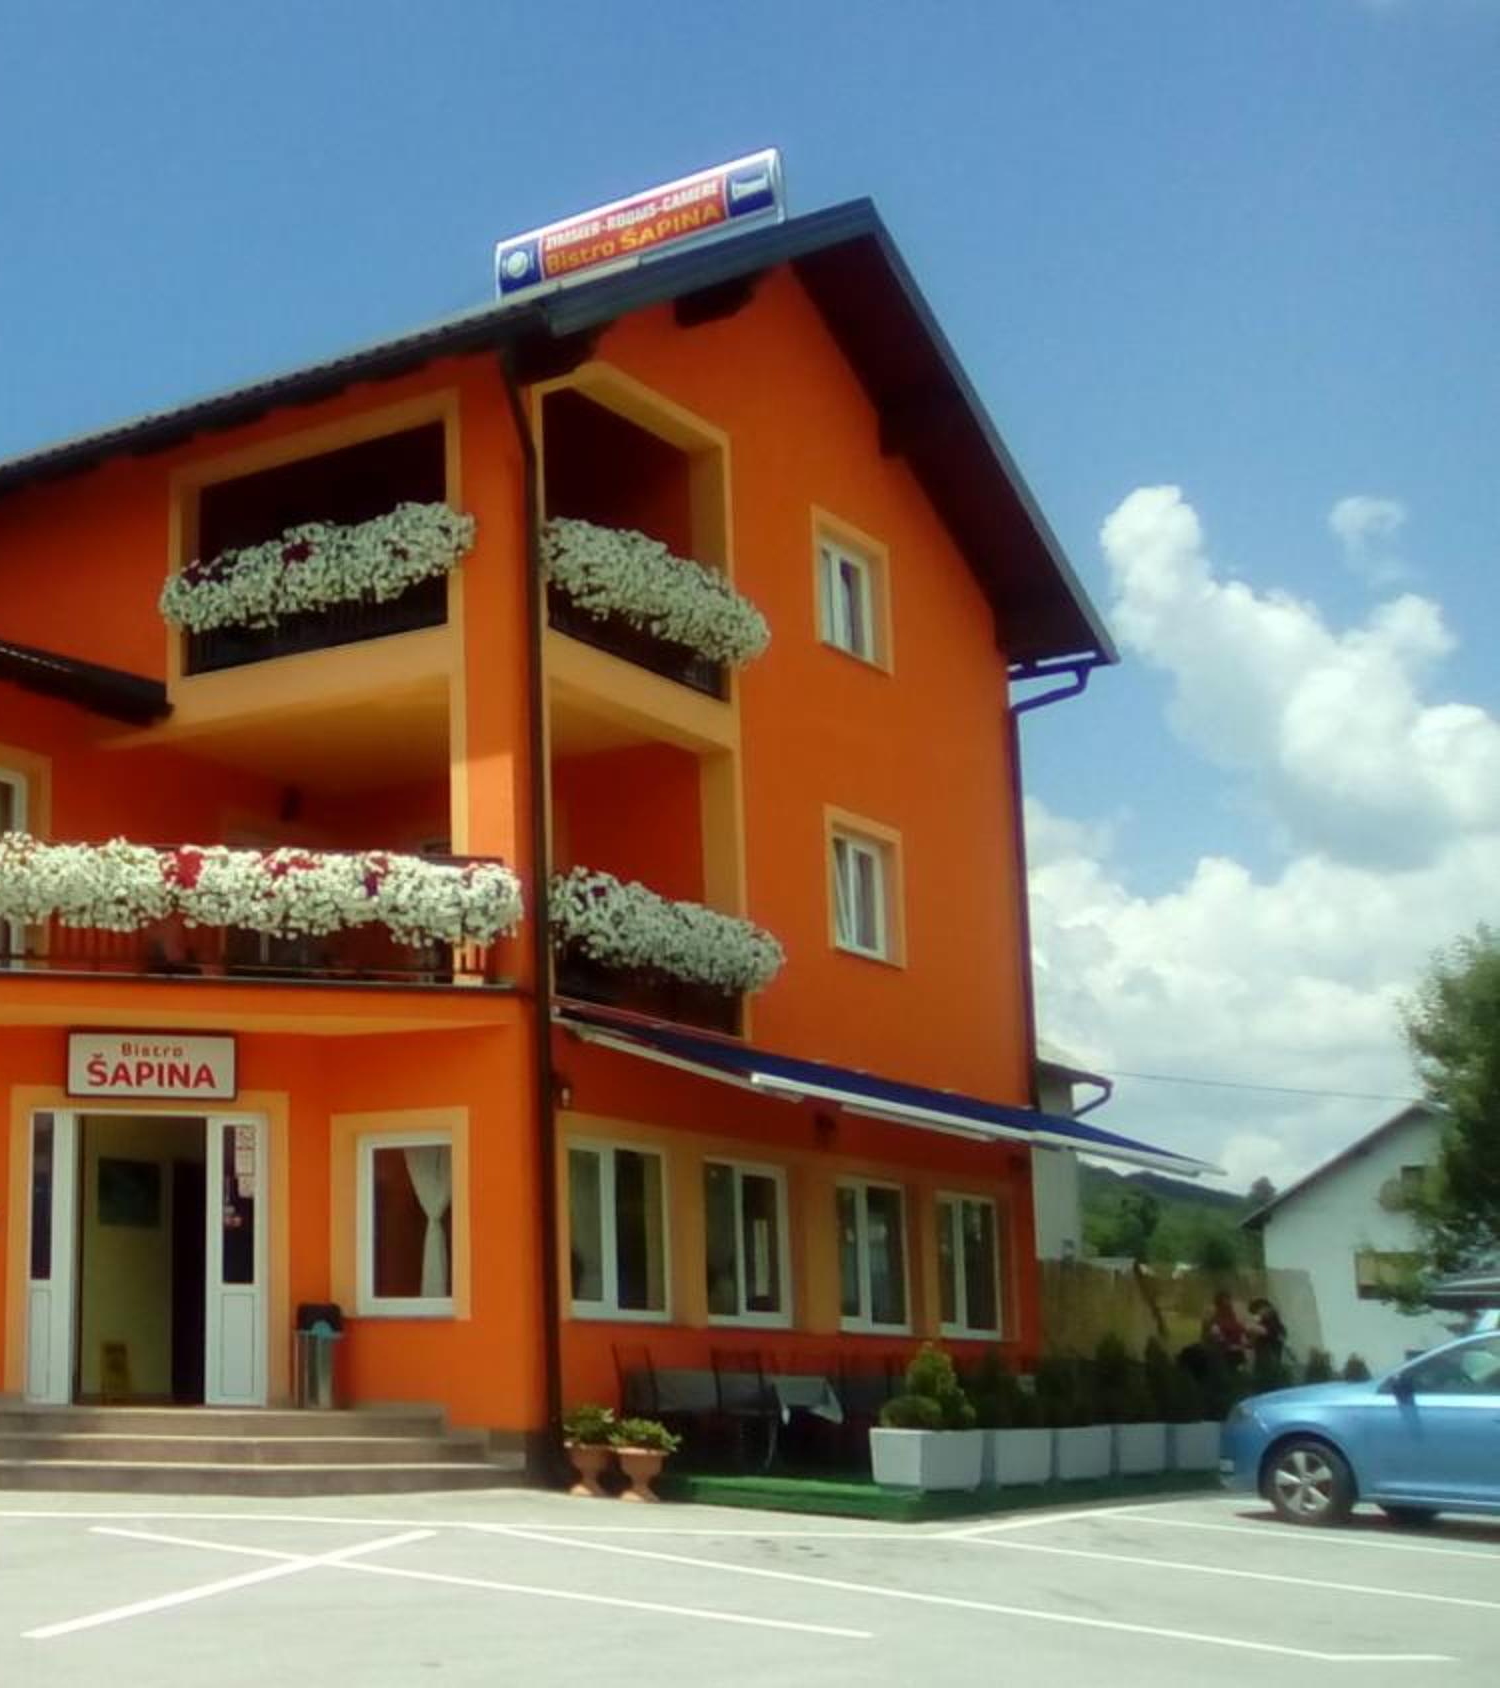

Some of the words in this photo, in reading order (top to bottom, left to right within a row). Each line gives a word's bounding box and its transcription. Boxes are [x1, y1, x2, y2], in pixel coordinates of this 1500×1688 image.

[547, 240, 615, 275] Bistro
[121, 1041, 184, 1057] Bistro
[86, 1053, 217, 1089] ŠAPINA
